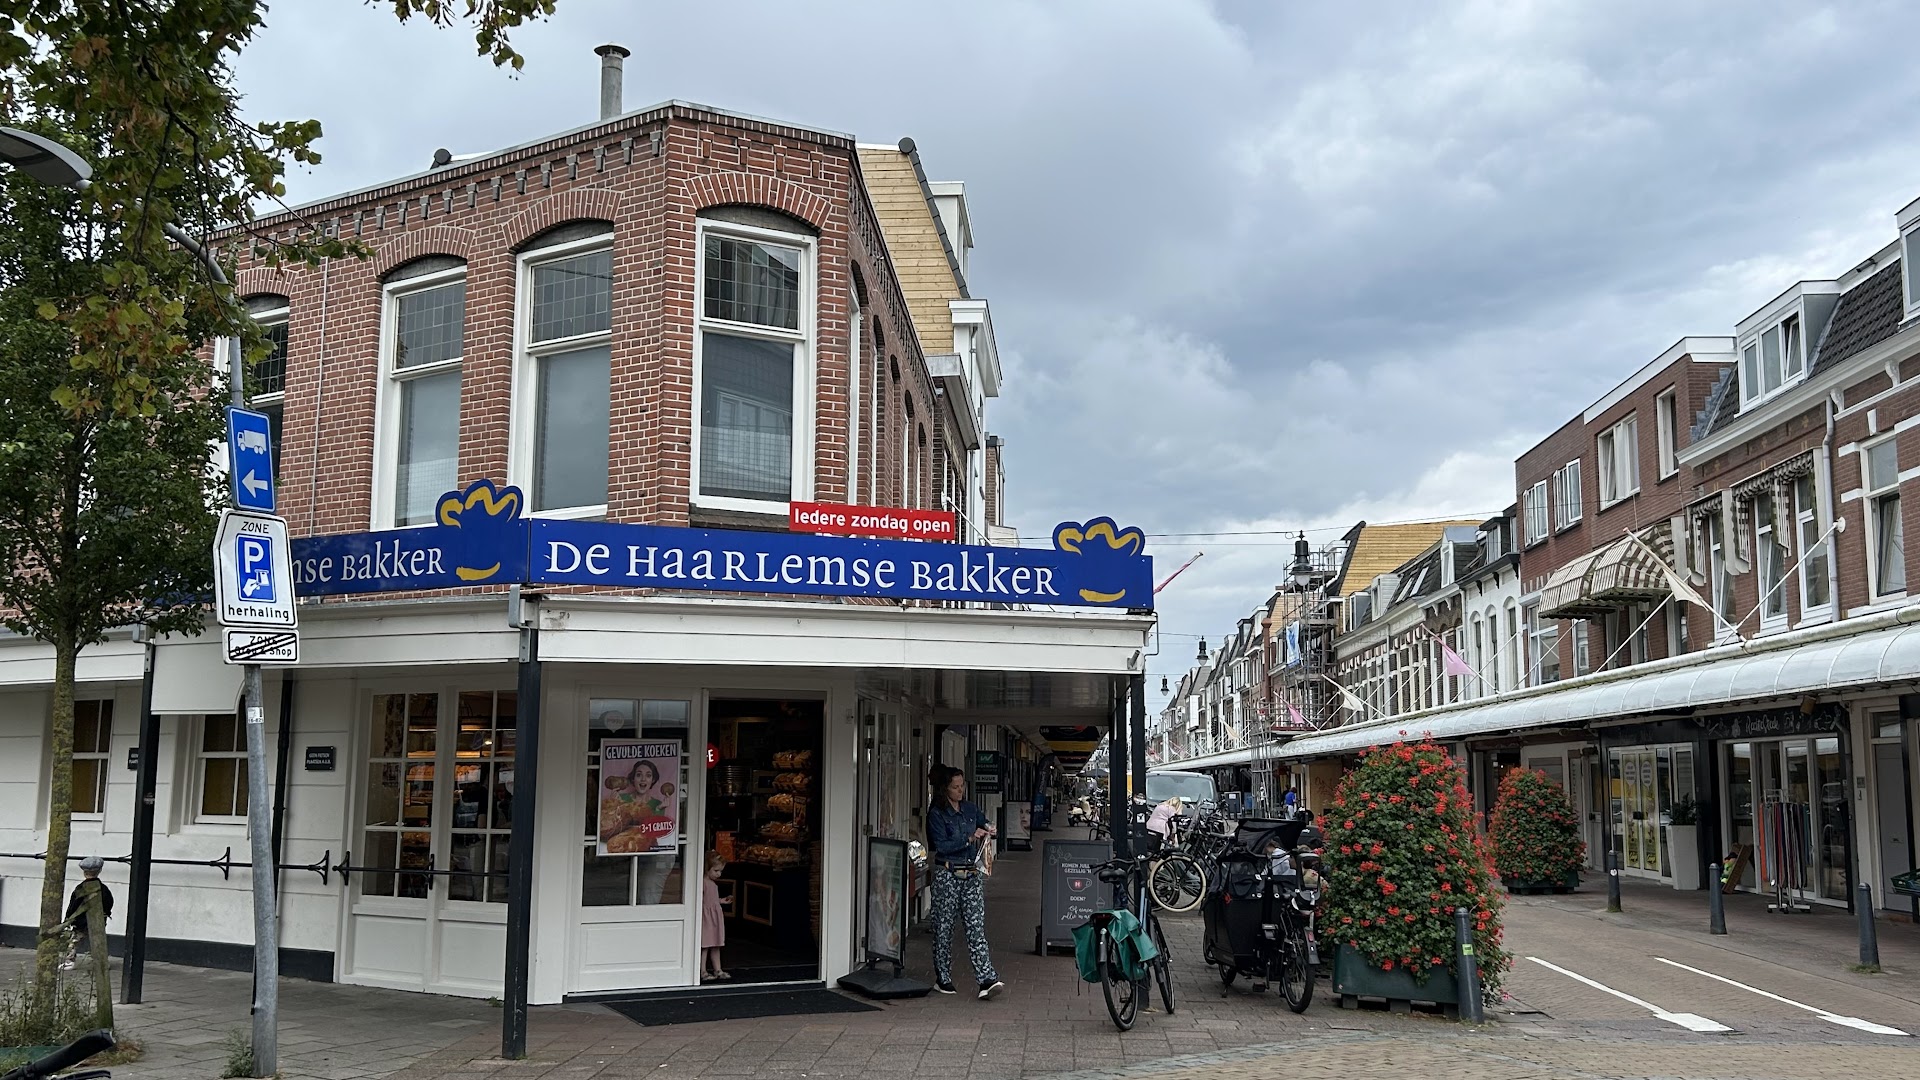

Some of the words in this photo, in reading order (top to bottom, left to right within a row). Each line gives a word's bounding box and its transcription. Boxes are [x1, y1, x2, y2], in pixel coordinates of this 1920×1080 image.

[241, 521, 270, 534] ZONE
[794, 508, 846, 526] Iedere
[851, 514, 908, 533] zondag
[913, 519, 951, 534] open
[244, 541, 264, 574] P
[545, 541, 611, 576] De
[228, 604, 290, 622] herhaling
[606, 745, 642, 759] GEVULDE
[644, 743, 677, 757] KOEKEN
[641, 823, 652, 833] 3+1
[652, 821, 673, 832] GRATIS
